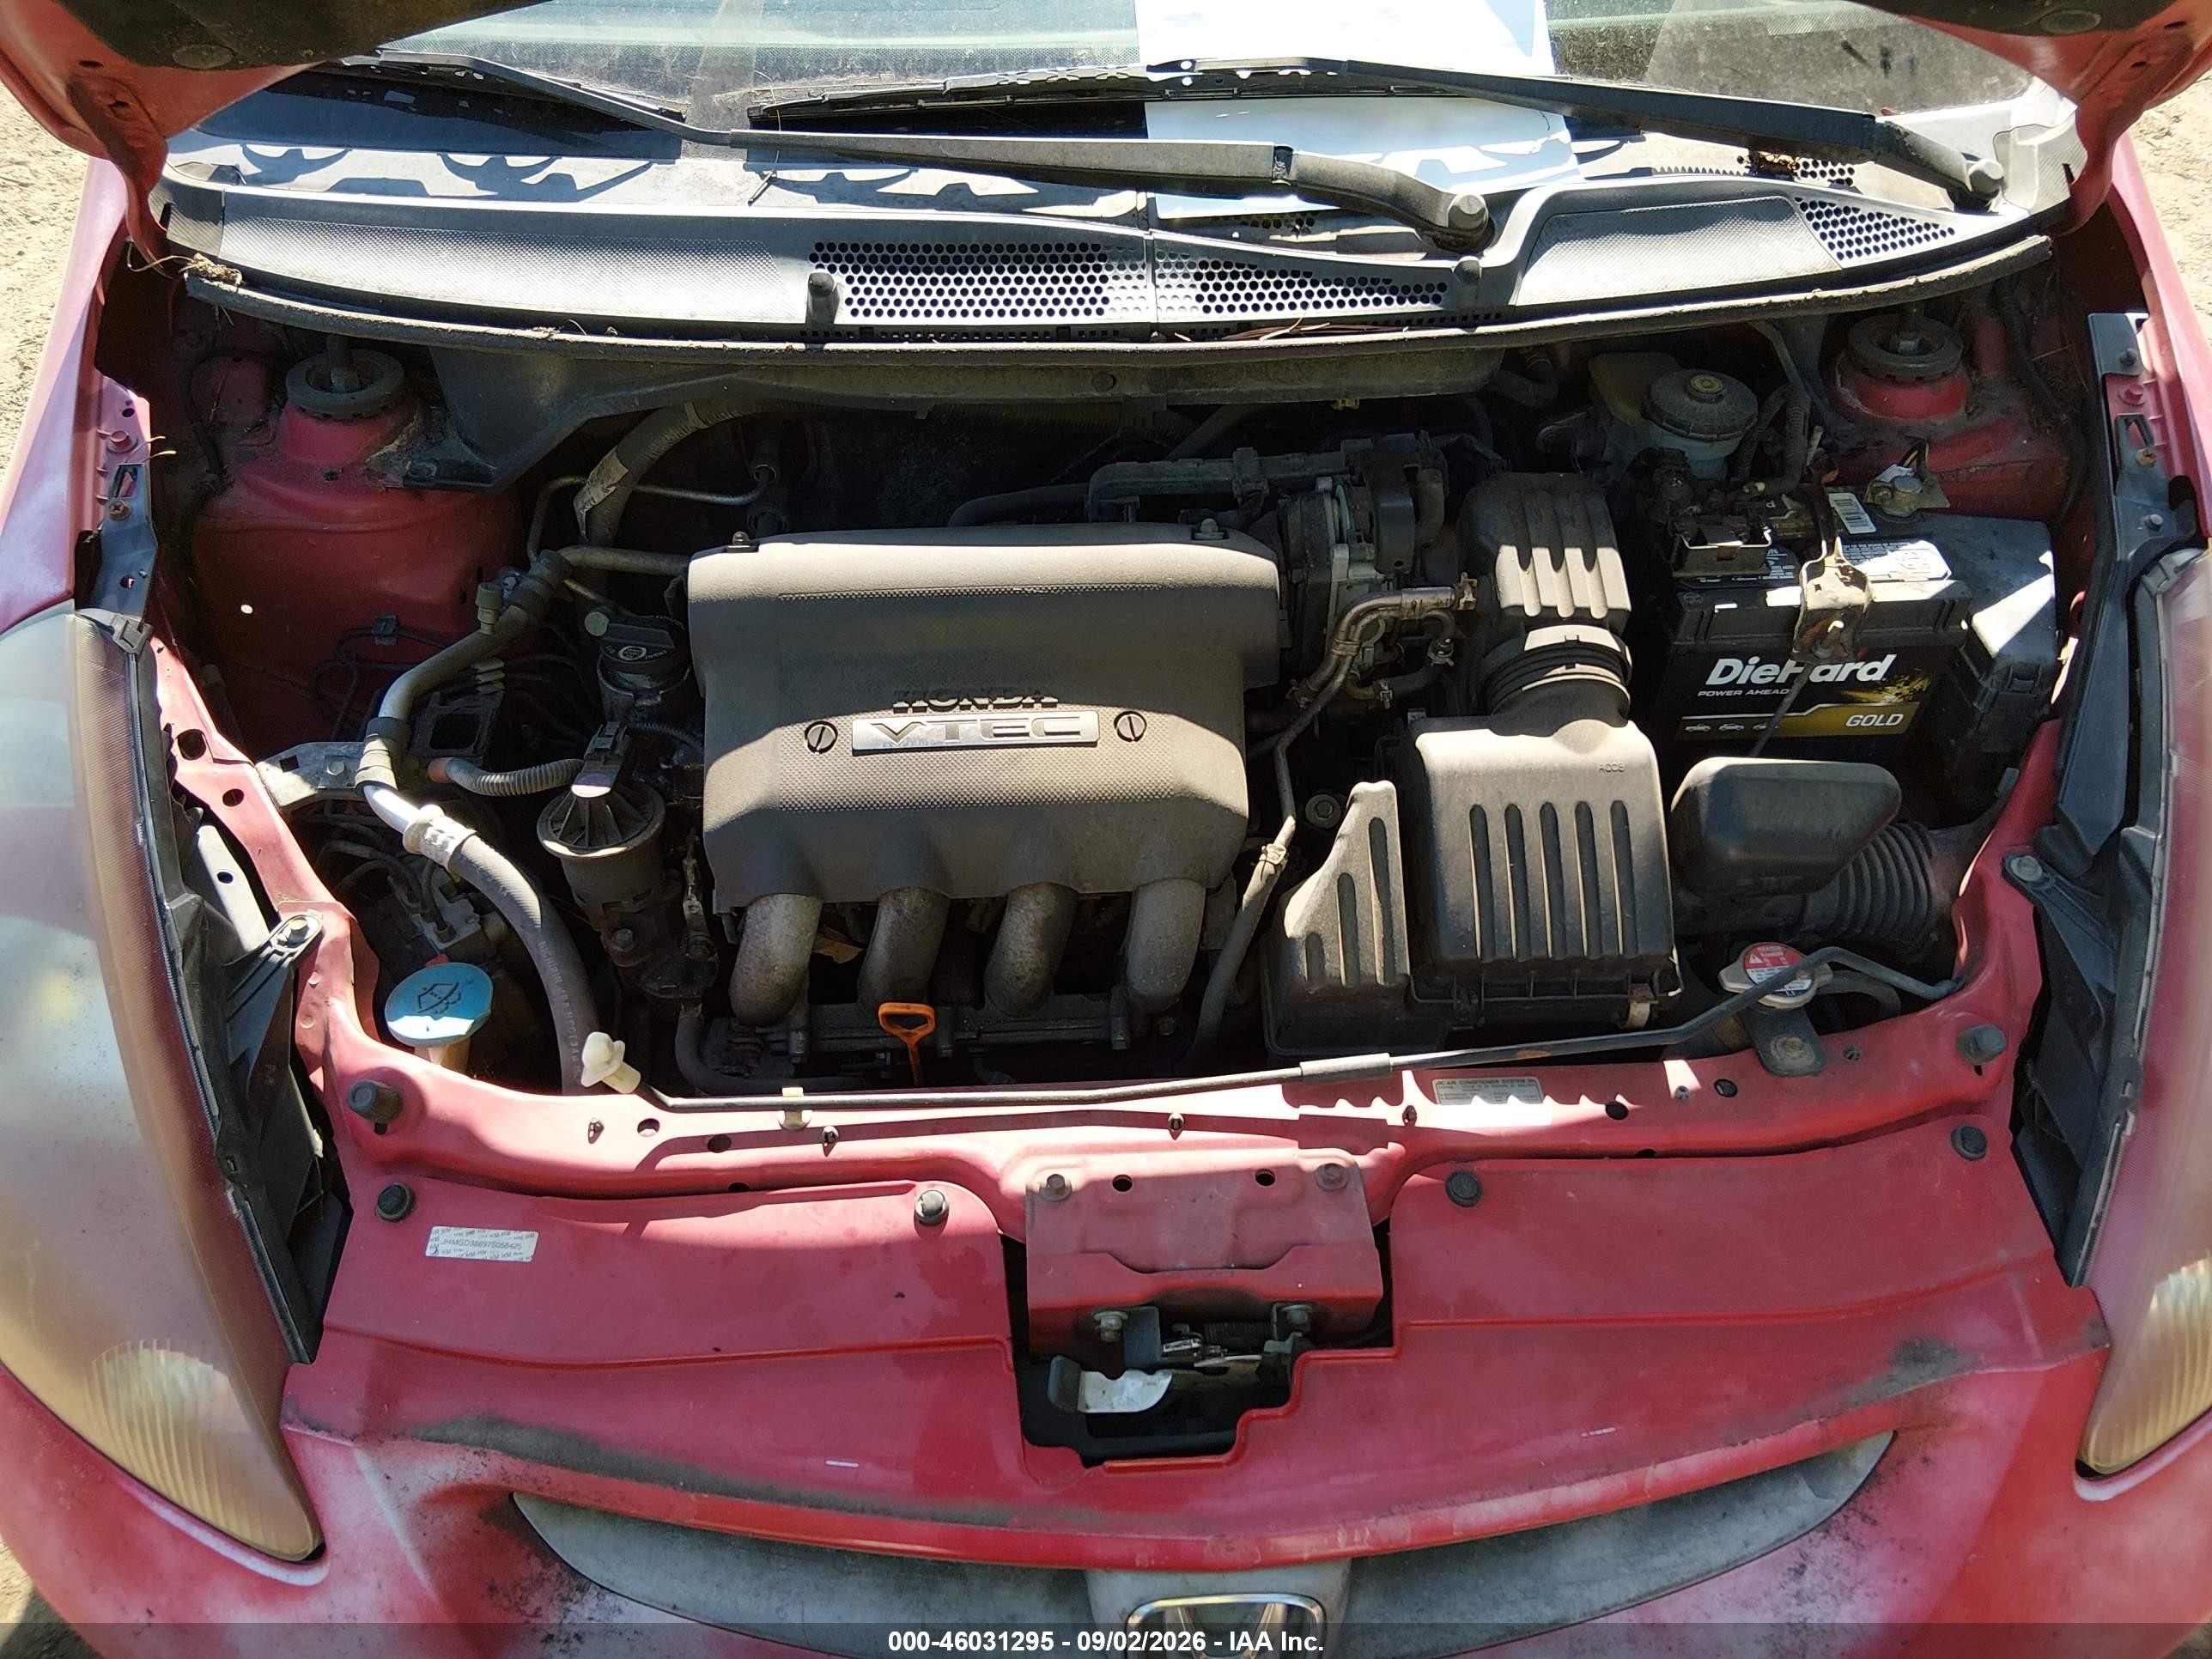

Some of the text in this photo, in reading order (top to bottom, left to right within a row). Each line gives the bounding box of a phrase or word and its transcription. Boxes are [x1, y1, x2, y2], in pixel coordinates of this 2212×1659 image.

[1698, 689, 1742, 697] POWER
[1845, 714, 1905, 728] GOLD
[871, 716, 1082, 746] VTEC
